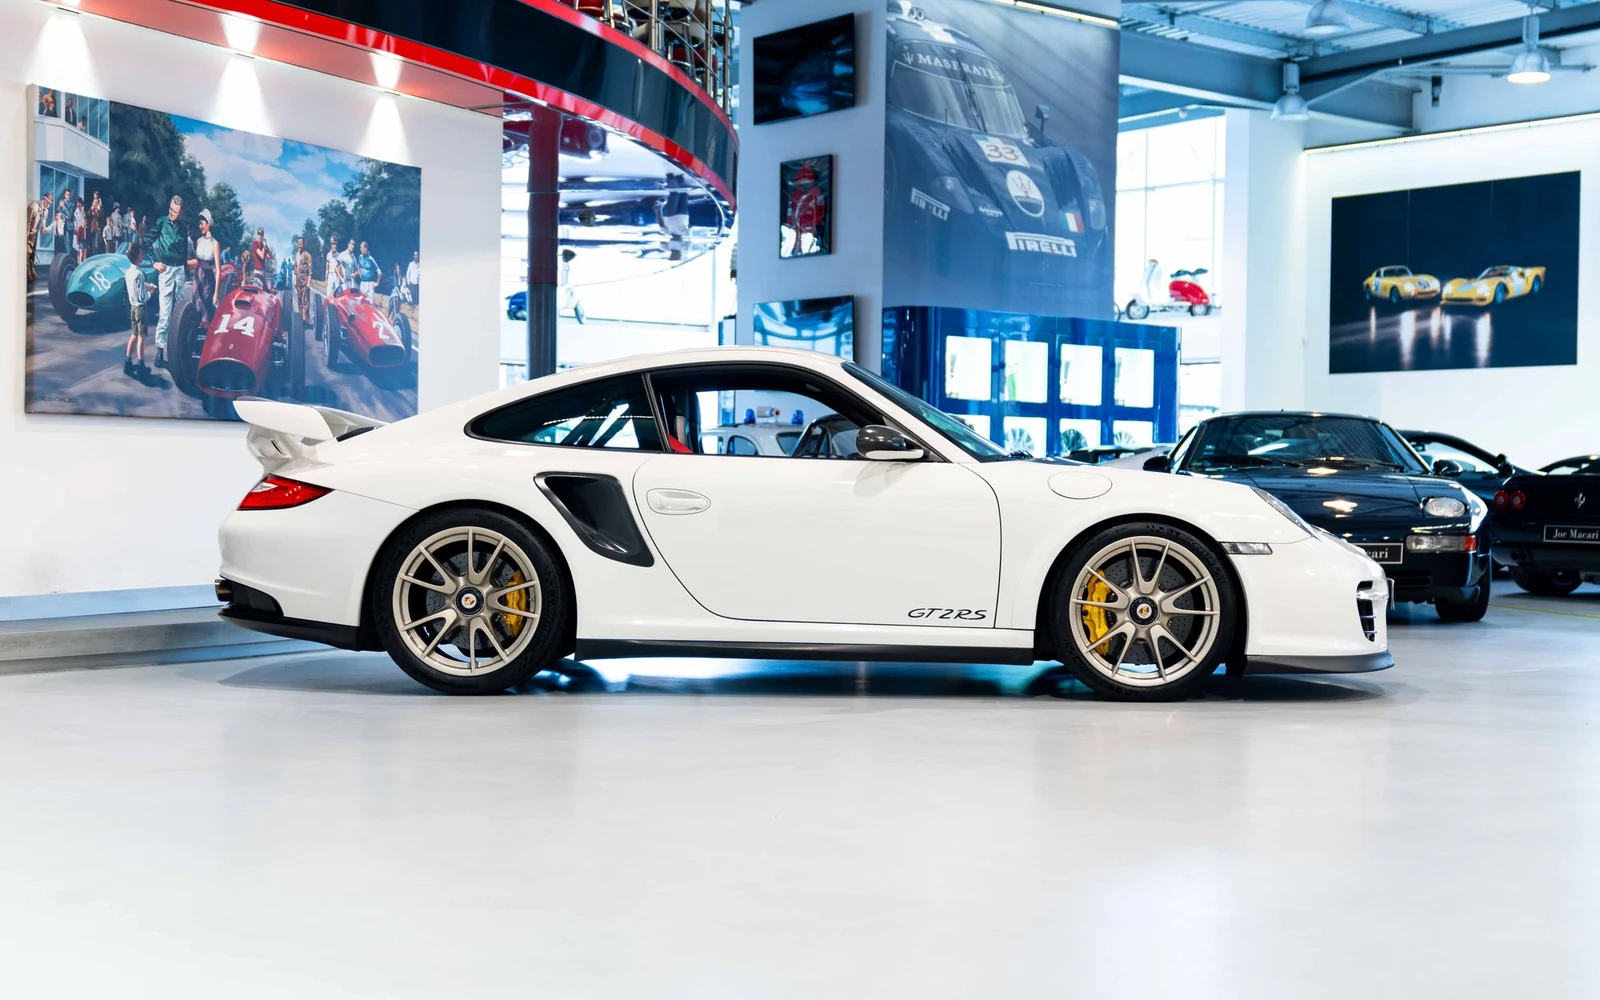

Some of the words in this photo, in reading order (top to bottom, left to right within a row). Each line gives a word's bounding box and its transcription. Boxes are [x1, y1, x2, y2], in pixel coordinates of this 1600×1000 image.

[917, 53, 996, 79] MASERATI
[986, 144, 1019, 161] 33
[911, 187, 950, 221] PIRLLI
[1005, 231, 1077, 258] PIRELLI
[89, 271, 111, 291] 18
[214, 314, 255, 338] 14
[1553, 528, 1567, 539] Joe
[1570, 529, 1599, 540] Macari
